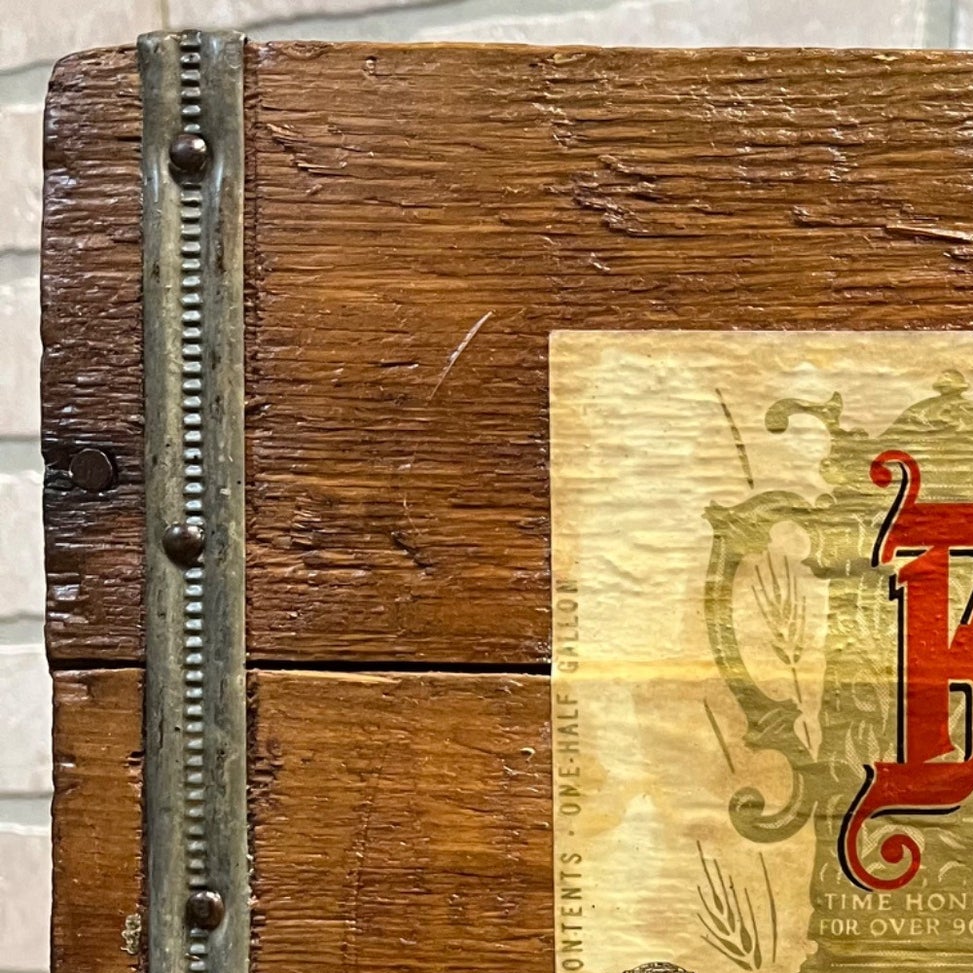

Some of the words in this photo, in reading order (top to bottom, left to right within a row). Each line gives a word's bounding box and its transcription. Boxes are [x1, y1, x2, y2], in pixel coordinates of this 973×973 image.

[556, 579, 579, 674] GALLON
[556, 693, 581, 814] ONE-HALF
[820, 918, 861, 936] FOR
[870, 918, 940, 937] OVER
[824, 892, 892, 911] TIME
